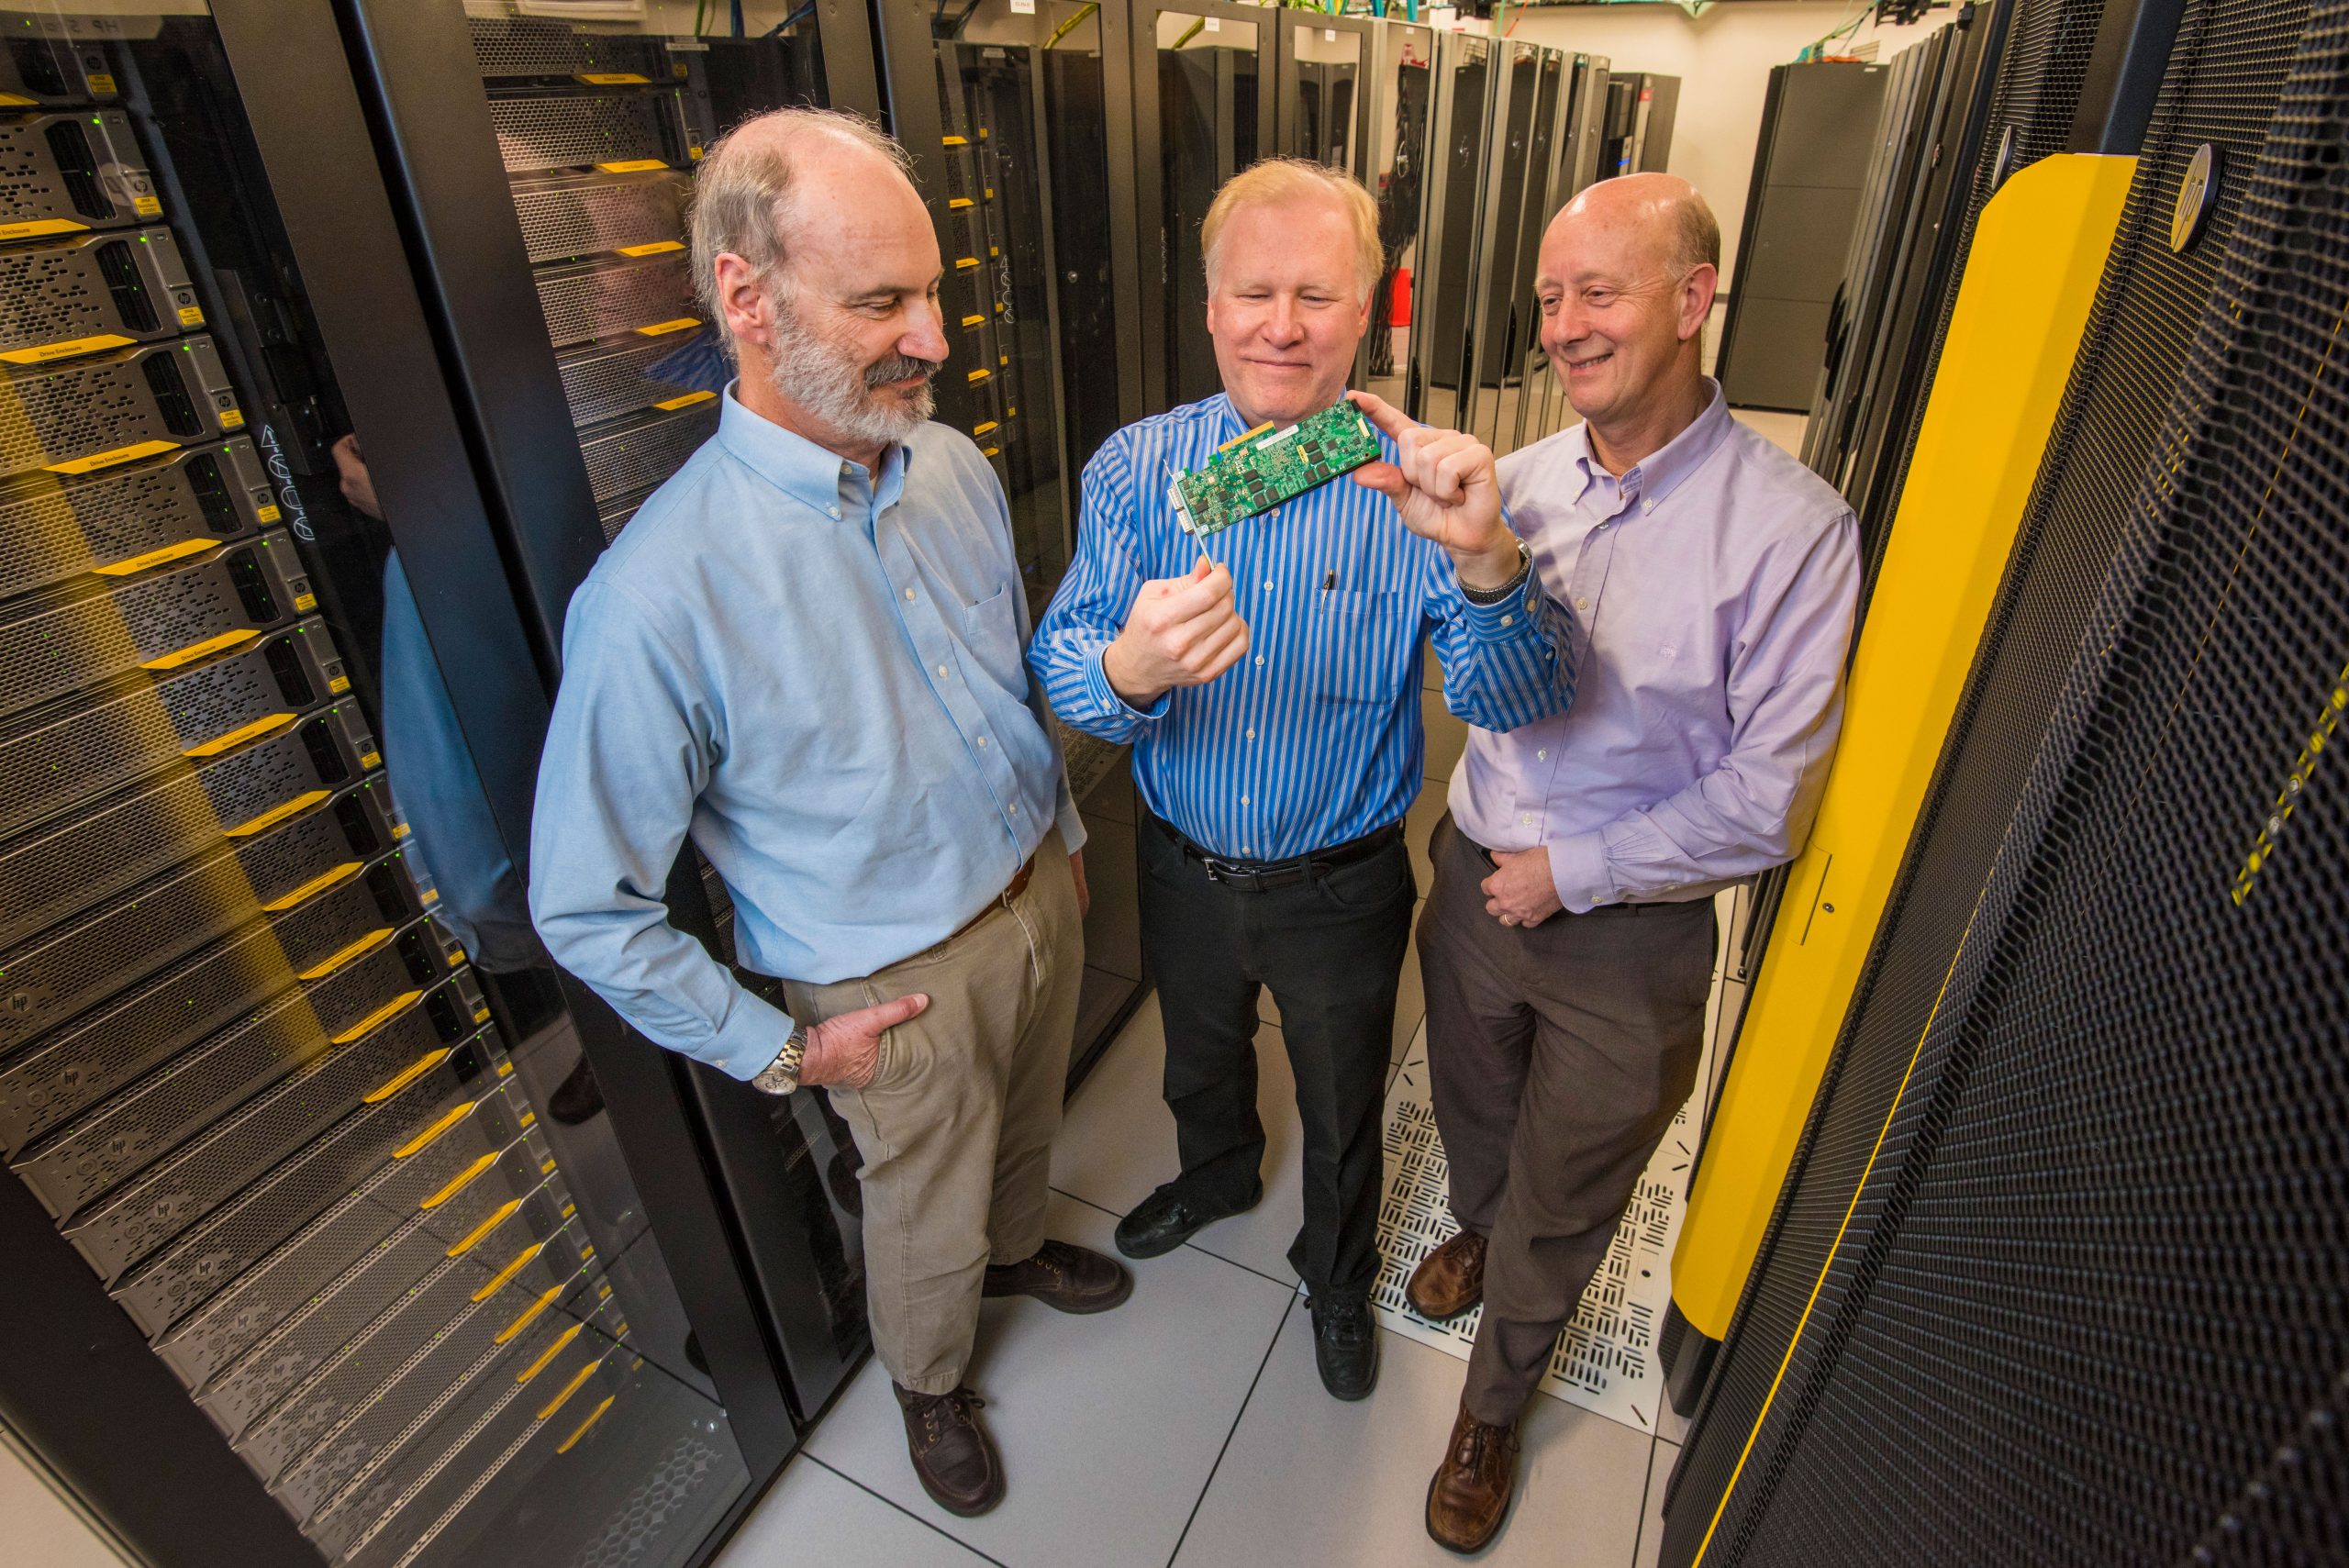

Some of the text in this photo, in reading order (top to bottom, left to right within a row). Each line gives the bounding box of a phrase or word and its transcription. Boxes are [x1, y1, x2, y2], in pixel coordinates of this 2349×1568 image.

[178, 293, 191, 305] hp
[55, 346, 83, 355] Enclosure
[105, 453, 129, 463] Enclosure
[12, 995, 28, 1011] hp
[64, 1071, 79, 1086] hp
[112, 1140, 126, 1155] hp
[158, 1203, 171, 1217] hp
[199, 1262, 211, 1275] hp
